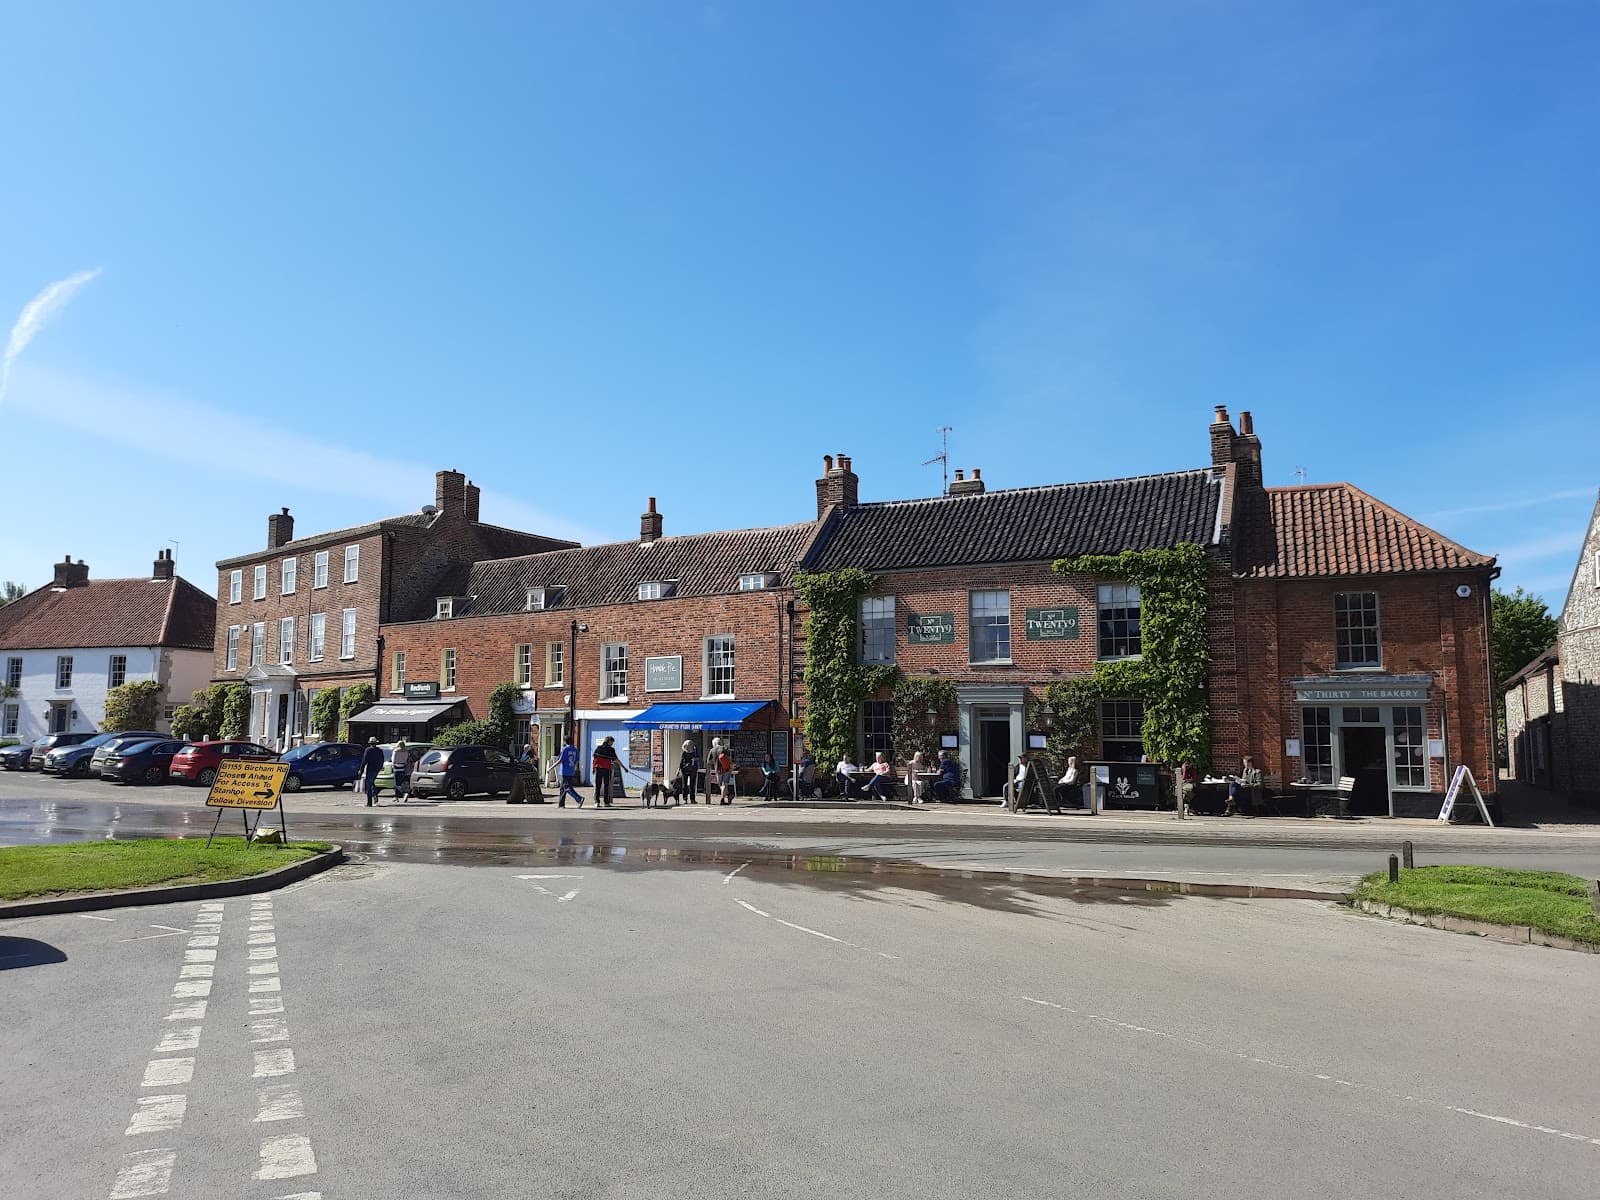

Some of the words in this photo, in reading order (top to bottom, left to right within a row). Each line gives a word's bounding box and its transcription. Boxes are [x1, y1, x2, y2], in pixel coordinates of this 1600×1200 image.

[1314, 690, 1351, 698] THIRTY
[244, 764, 274, 772] Bircham
[220, 771, 245, 779] Closed
[213, 787, 245, 795] Stanhoe
[209, 796, 234, 804] Follow
[236, 798, 273, 806] Diversion
